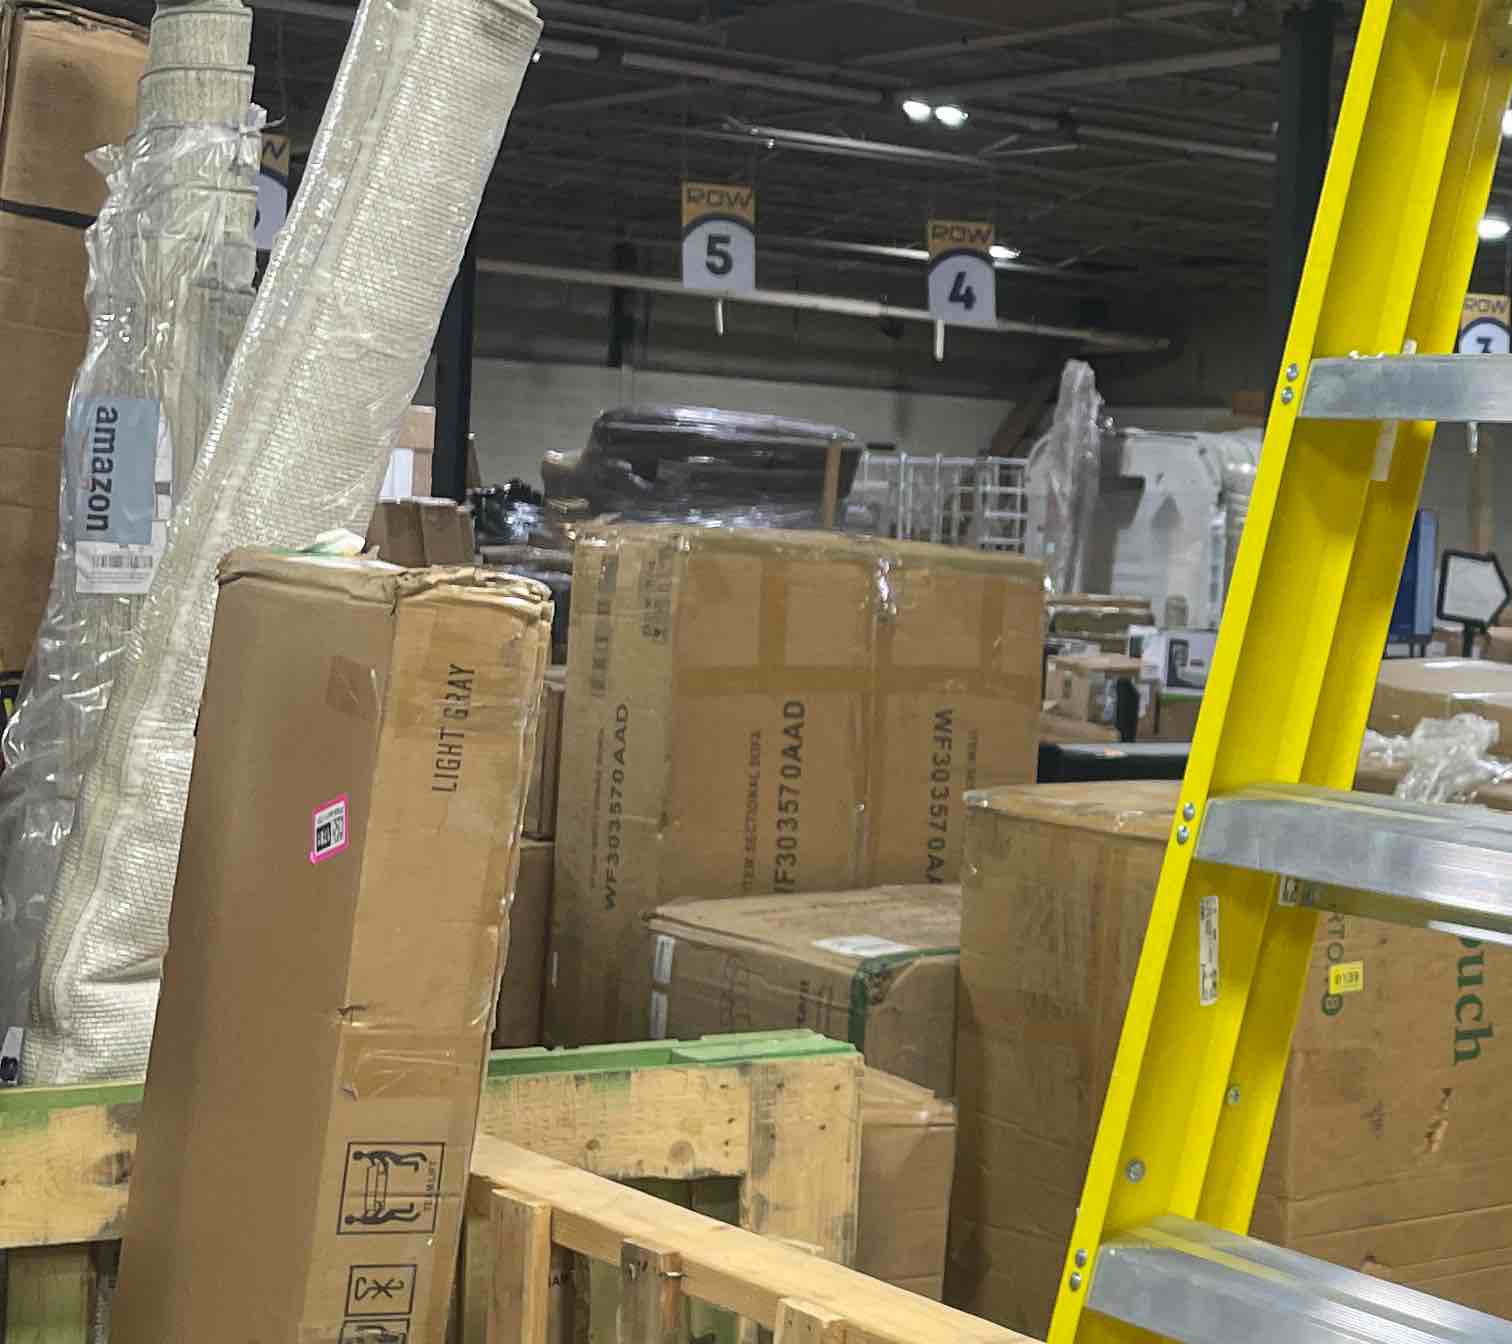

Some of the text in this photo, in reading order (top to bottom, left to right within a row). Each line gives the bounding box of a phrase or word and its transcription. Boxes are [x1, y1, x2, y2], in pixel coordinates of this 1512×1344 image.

[687, 187, 753, 209] ROW
[705, 233, 733, 275] 5
[931, 223, 993, 244] ROW
[949, 271, 977, 311] 4
[86, 405, 118, 533] amazon
[432, 663, 476, 793] LIGHT GRAY
